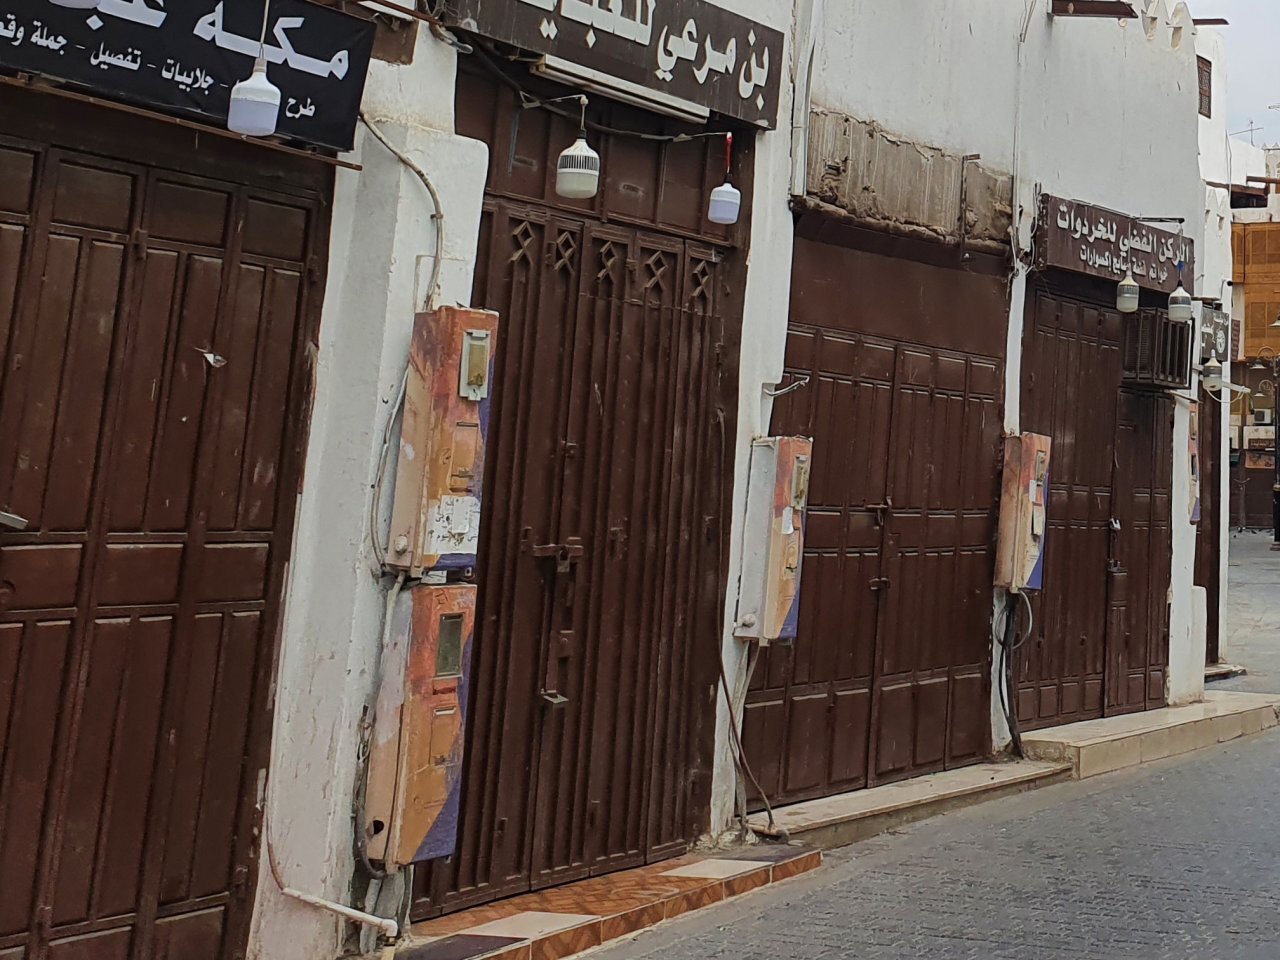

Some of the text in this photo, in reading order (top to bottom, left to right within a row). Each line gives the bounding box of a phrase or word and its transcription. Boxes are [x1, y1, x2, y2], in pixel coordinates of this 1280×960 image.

[30, 20, 68, 55] جملة
[90, 41, 142, 71] تفصيل
[656, 18, 737, 84] مرعي
[161, 58, 214, 95] جلابيات
[738, 28, 770, 111] بن
[285, 96, 316, 119] طرح
[1056, 203, 1189, 266] الركن الفضي للخردوات
